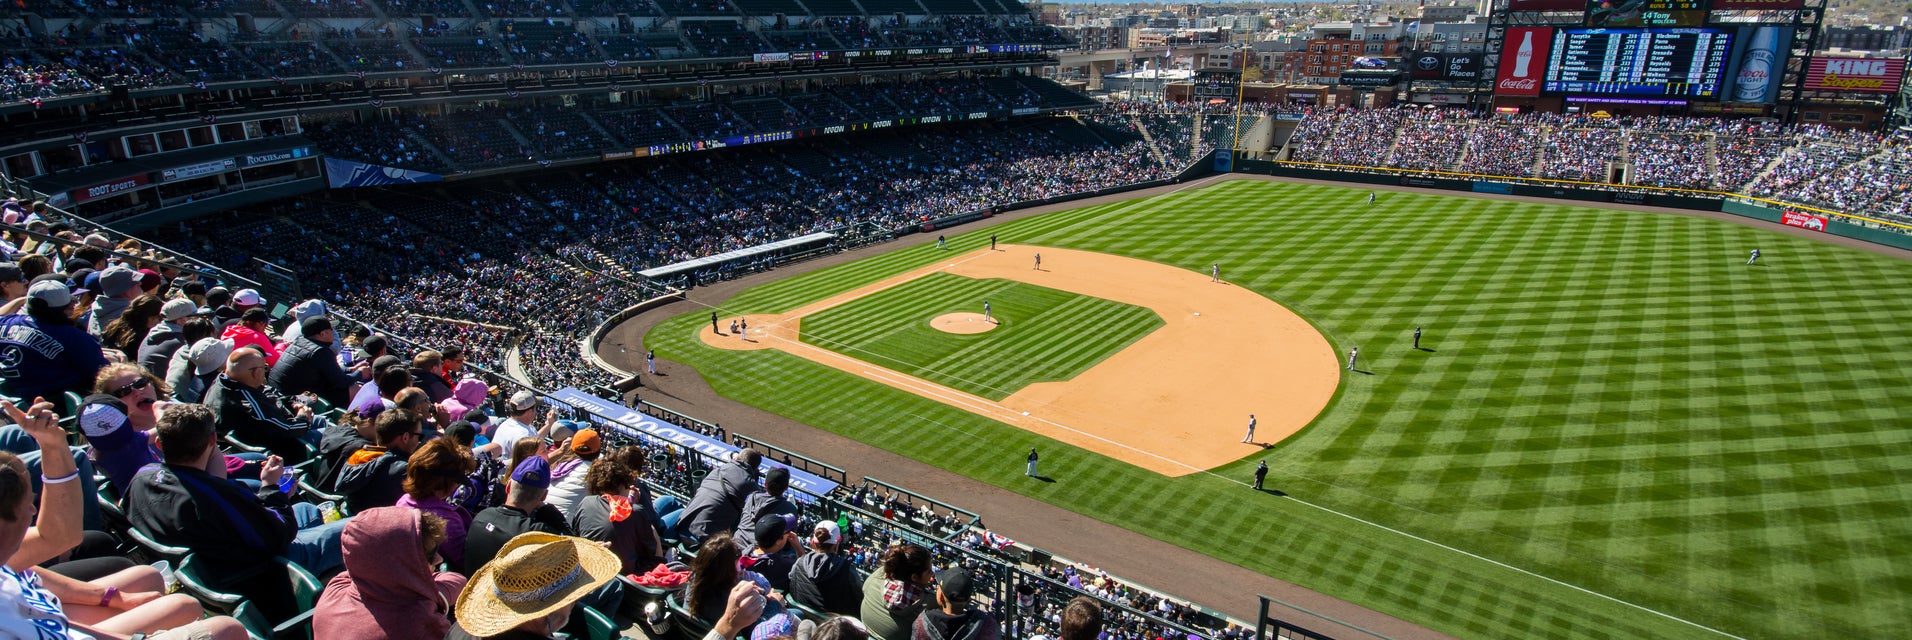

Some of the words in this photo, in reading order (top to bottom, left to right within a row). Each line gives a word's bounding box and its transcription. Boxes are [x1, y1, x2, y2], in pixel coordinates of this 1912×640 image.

[1653, 12, 1671, 20] Tony
[1451, 57, 1471, 65] Let's
[1449, 70, 1476, 78] Places
[1825, 60, 1887, 76] KING
[1820, 73, 1884, 91] Soopers
[247, 153, 291, 166] ROCKIES.com
[88, 184, 111, 197] ROOT
[111, 180, 136, 192] SPORTS
[1784, 211, 1809, 222] brakes
[1786, 218, 1802, 227] plus
[1, 345, 24, 378] 2
